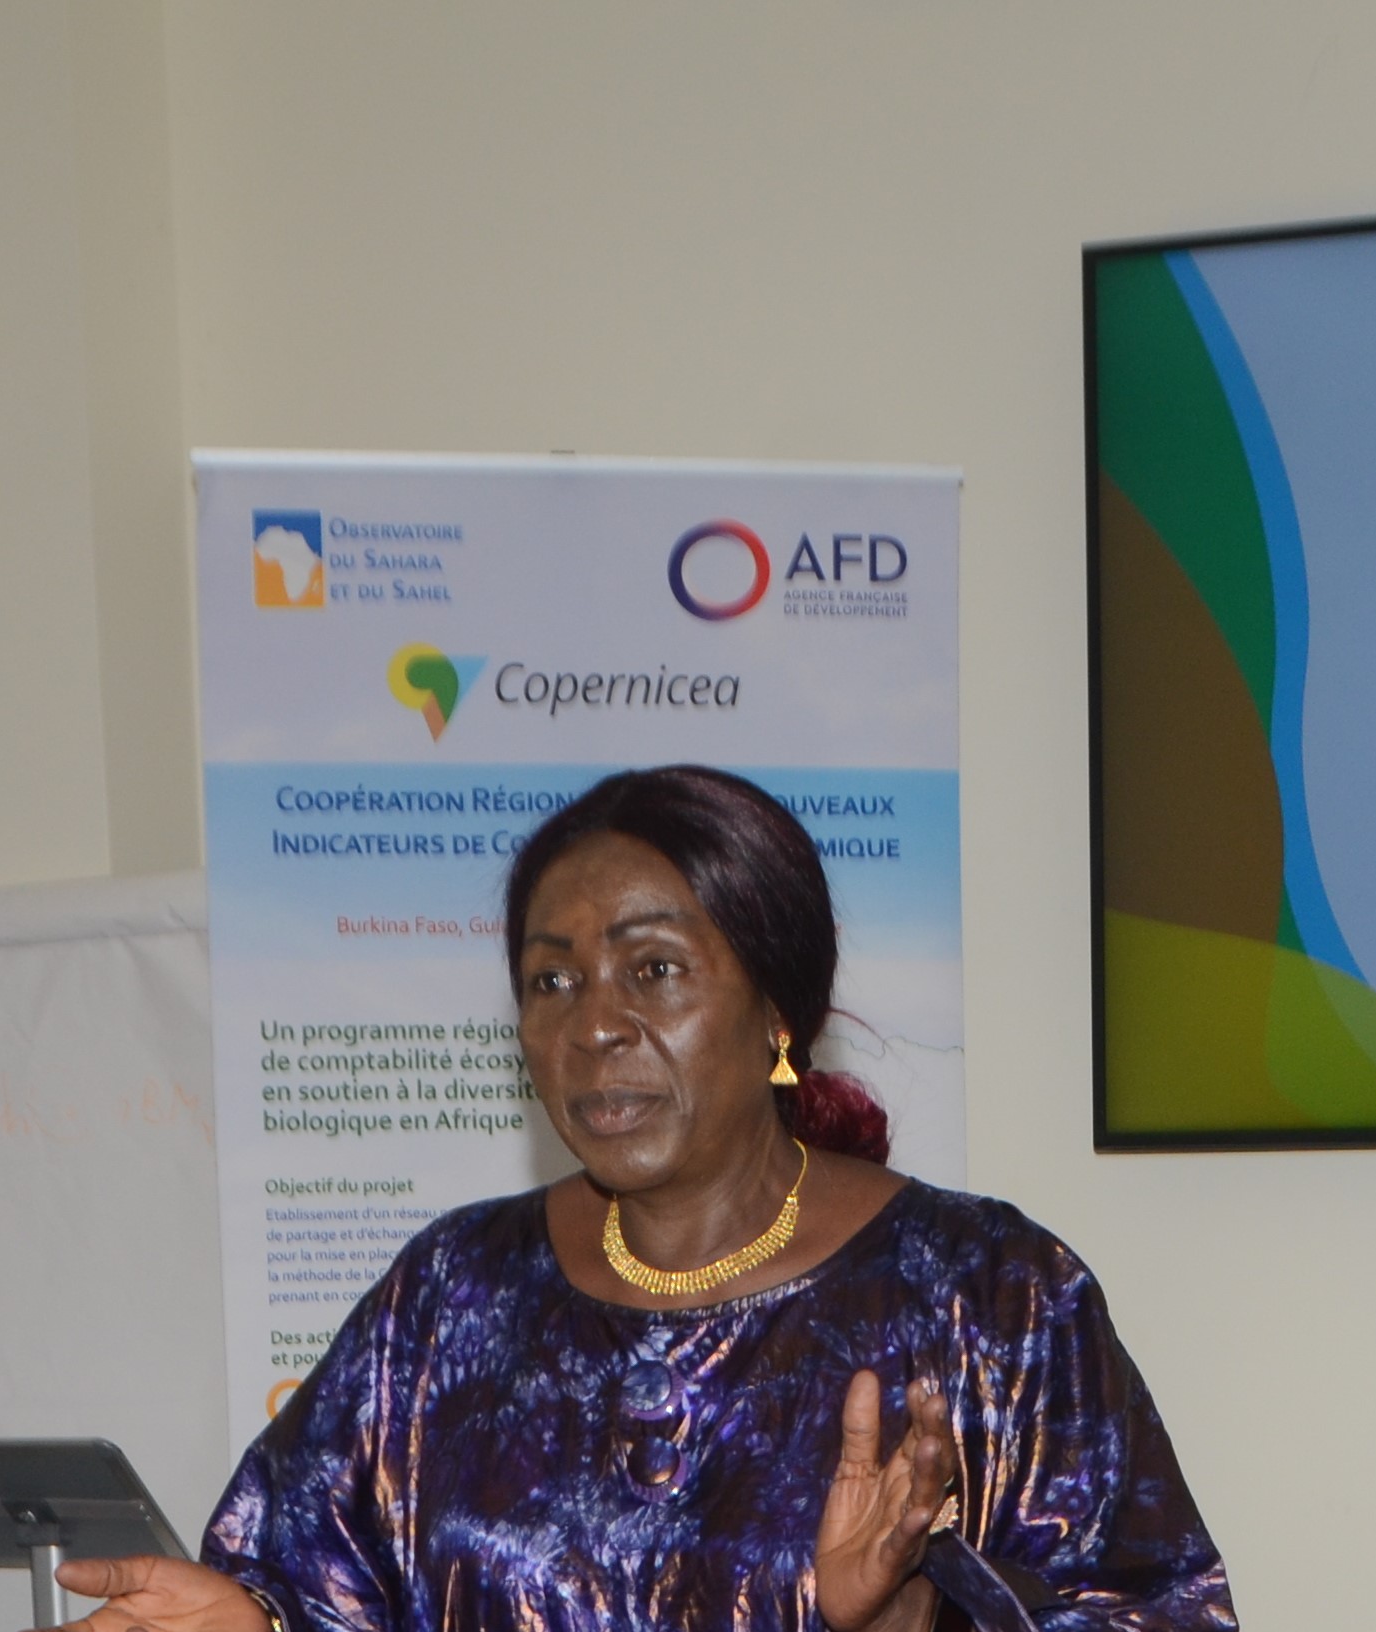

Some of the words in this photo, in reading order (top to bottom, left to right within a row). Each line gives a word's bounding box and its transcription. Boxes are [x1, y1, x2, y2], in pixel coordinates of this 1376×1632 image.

[329, 517, 463, 542] OBSERVATOIRE
[329, 553, 355, 570] DU
[365, 549, 442, 571] SAHARA
[785, 531, 908, 582] AFD
[393, 579, 452, 601] SAHEL
[784, 590, 836, 602] AGENCE
[840, 590, 907, 604] FRANÇAISE
[784, 604, 799, 615] DE
[805, 602, 908, 617] DÉVELOPPEMENT
[495, 662, 740, 716] Copernicea
[276, 783, 464, 813] COOPÉRATION
[472, 784, 575, 813] RÉGION
[774, 794, 895, 817] OUVEAUX
[272, 830, 444, 856] INDICATEURS
[453, 834, 485, 855] DE
[815, 837, 901, 858] MIQUE
[337, 917, 409, 934] Burkina
[415, 917, 463, 937] Faso,
[261, 1020, 295, 1041] Un
[303, 1024, 445, 1046] programme
[262, 1050, 290, 1070] de
[298, 1048, 452, 1075] comptabilité
[460, 1047, 527, 1074] écosy
[262, 1084, 291, 1101] en
[299, 1079, 389, 1101] soutien
[397, 1078, 409, 1100] à
[417, 1079, 437, 1100] la
[263, 1110, 393, 1136] biologique
[400, 1114, 428, 1130] en
[435, 1109, 523, 1136] Afrique
[265, 1178, 333, 1197] Objectif
[337, 1178, 358, 1193] du
[363, 1177, 414, 1196] projet
[394, 1206, 437, 1219] réseau
[266, 1228, 283, 1241] de
[286, 1229, 337, 1244] partage
[340, 1230, 353, 1240] et
[356, 1227, 415, 1240] d'échang
[267, 1251, 296, 1265] pour
[300, 1248, 312, 1261] la
[315, 1249, 346, 1261] mise
[349, 1251, 366, 1261] en
[369, 1248, 397, 1263] plac
[267, 1270, 279, 1282] la
[282, 1269, 342, 1282] méthode
[344, 1268, 362, 1281] de
[364, 1268, 376, 1281] la
[269, 1291, 320, 1305] prenant
[322, 1291, 339, 1301] en
[271, 1331, 302, 1345] Des
[271, 1353, 288, 1365] et
